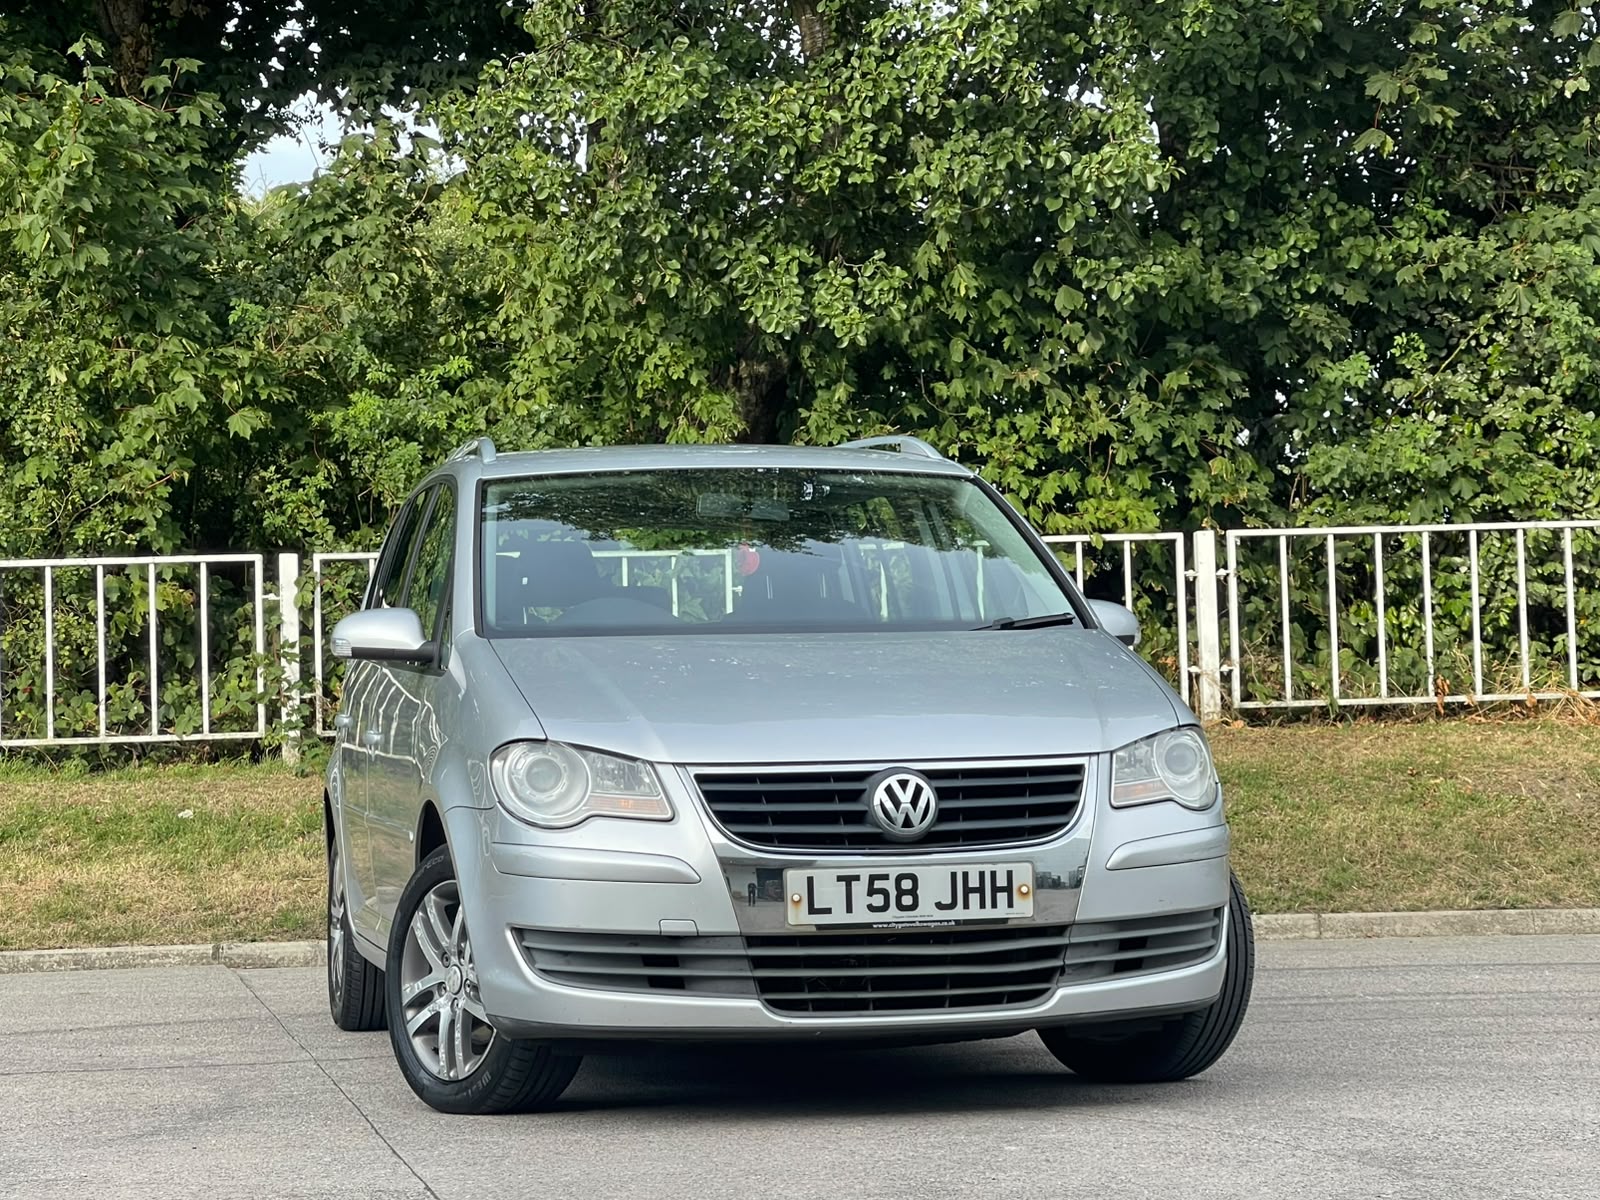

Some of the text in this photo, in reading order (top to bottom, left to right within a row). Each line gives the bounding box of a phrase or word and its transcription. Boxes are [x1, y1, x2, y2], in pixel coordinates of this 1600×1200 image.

[876, 776, 934, 832] VW
[806, 869, 1014, 916] LT58 JHH
